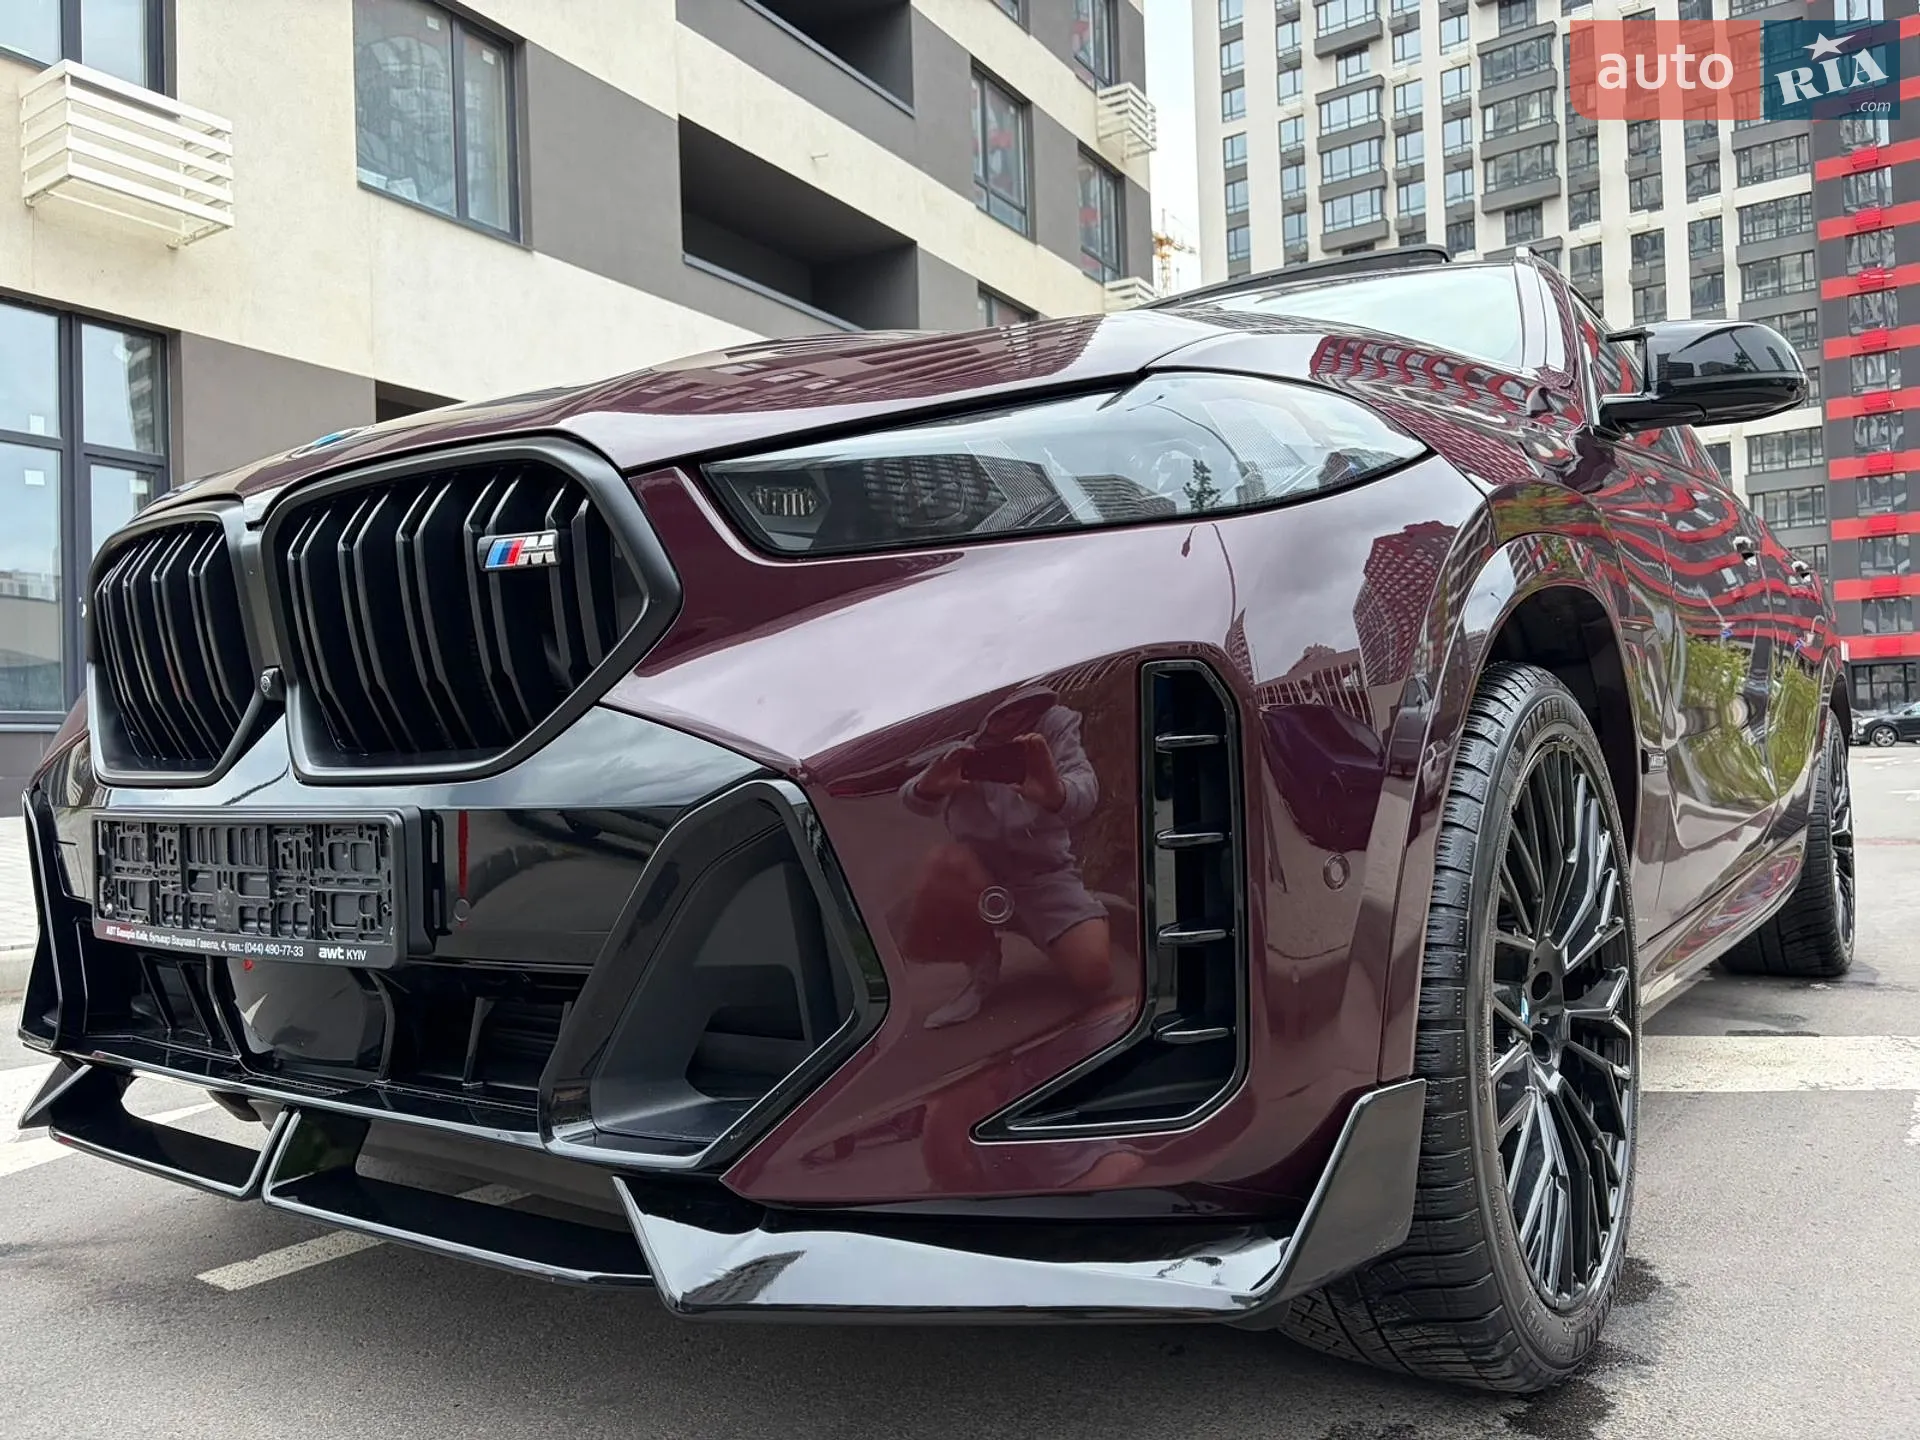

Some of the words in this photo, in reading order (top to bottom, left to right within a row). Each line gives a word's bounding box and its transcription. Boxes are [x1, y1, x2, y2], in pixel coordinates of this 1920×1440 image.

[244, 942, 263, 955] (044)
[265, 944, 303, 957] 490-77-33
[319, 946, 344, 960] awt
[346, 949, 367, 961] KYIV
